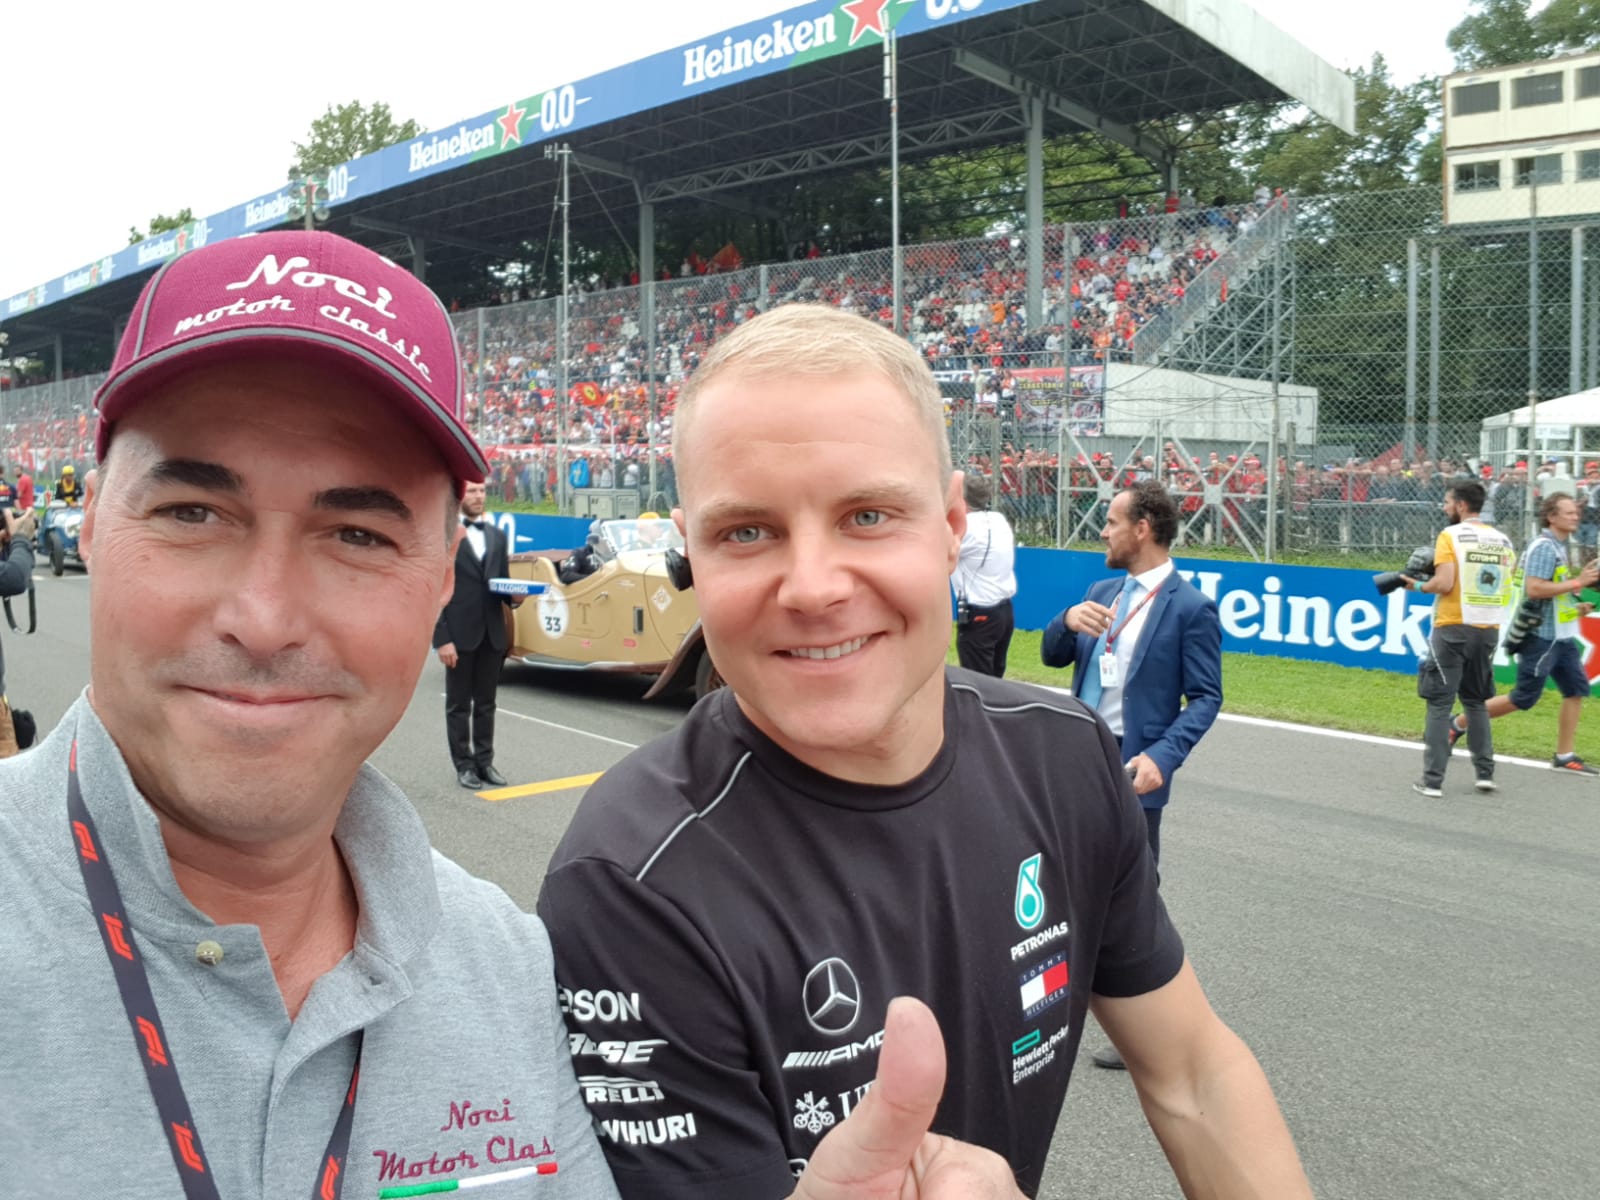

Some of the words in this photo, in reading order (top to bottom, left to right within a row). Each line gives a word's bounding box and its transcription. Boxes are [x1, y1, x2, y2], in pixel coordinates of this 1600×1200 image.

[682, 13, 837, 86] Heineken
[408, 122, 496, 173] Heineken
[541, 84, 576, 133] 0.0
[245, 192, 300, 228] Heinek
[226, 254, 397, 319] Noci
[173, 295, 296, 336] motor
[319, 304, 433, 383] classic
[544, 615, 562, 632] 33
[1010, 921, 1069, 961] PETRONAS
[1022, 954, 1063, 983] TOMMY
[1026, 988, 1065, 1017] HILFIGER
[1012, 1041, 1049, 1071] Hewlett
[440, 1098, 516, 1132] Noci
[373, 1149, 479, 1182] Motor
